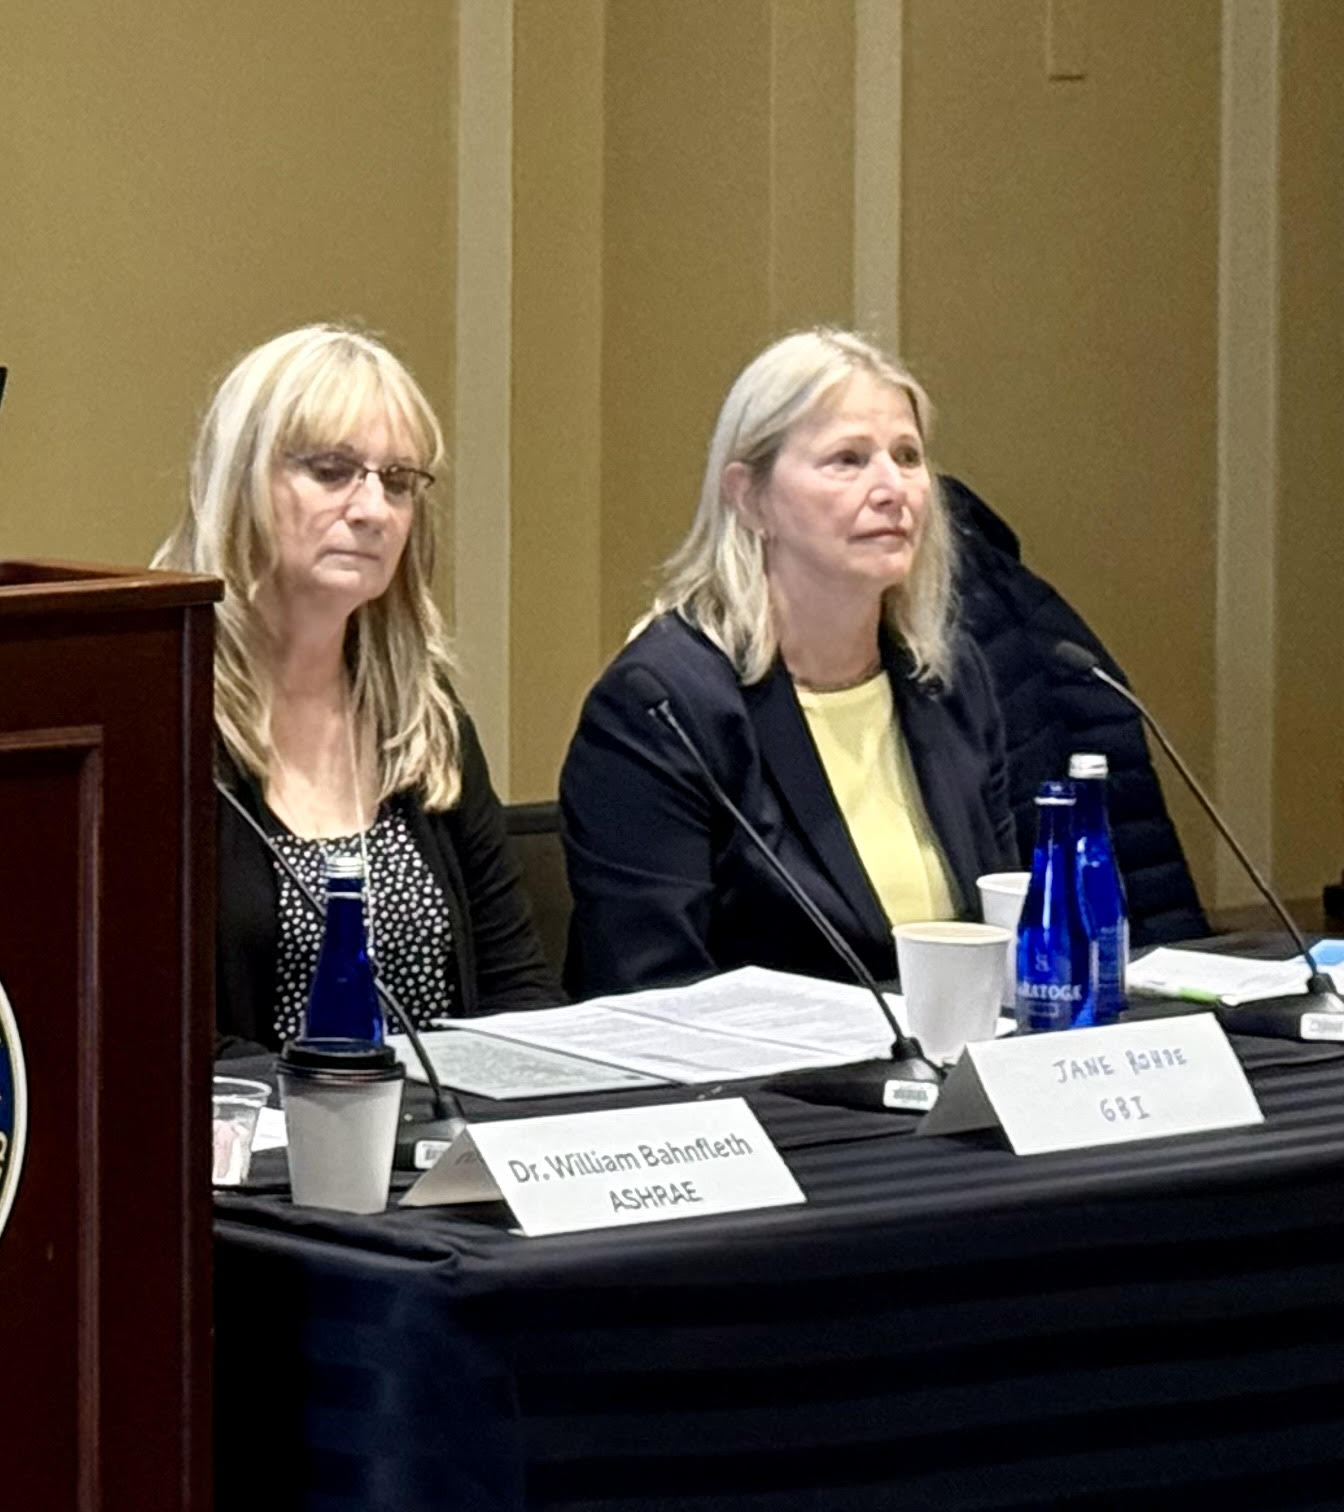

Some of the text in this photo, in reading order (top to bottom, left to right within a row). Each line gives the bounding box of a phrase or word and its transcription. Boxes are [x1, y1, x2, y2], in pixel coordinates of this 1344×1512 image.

[1052, 1056, 1115, 1084] JANE
[507, 1132, 754, 1185] Dr. William Bahnfleth
[608, 1181, 704, 1214] ASHRAE
